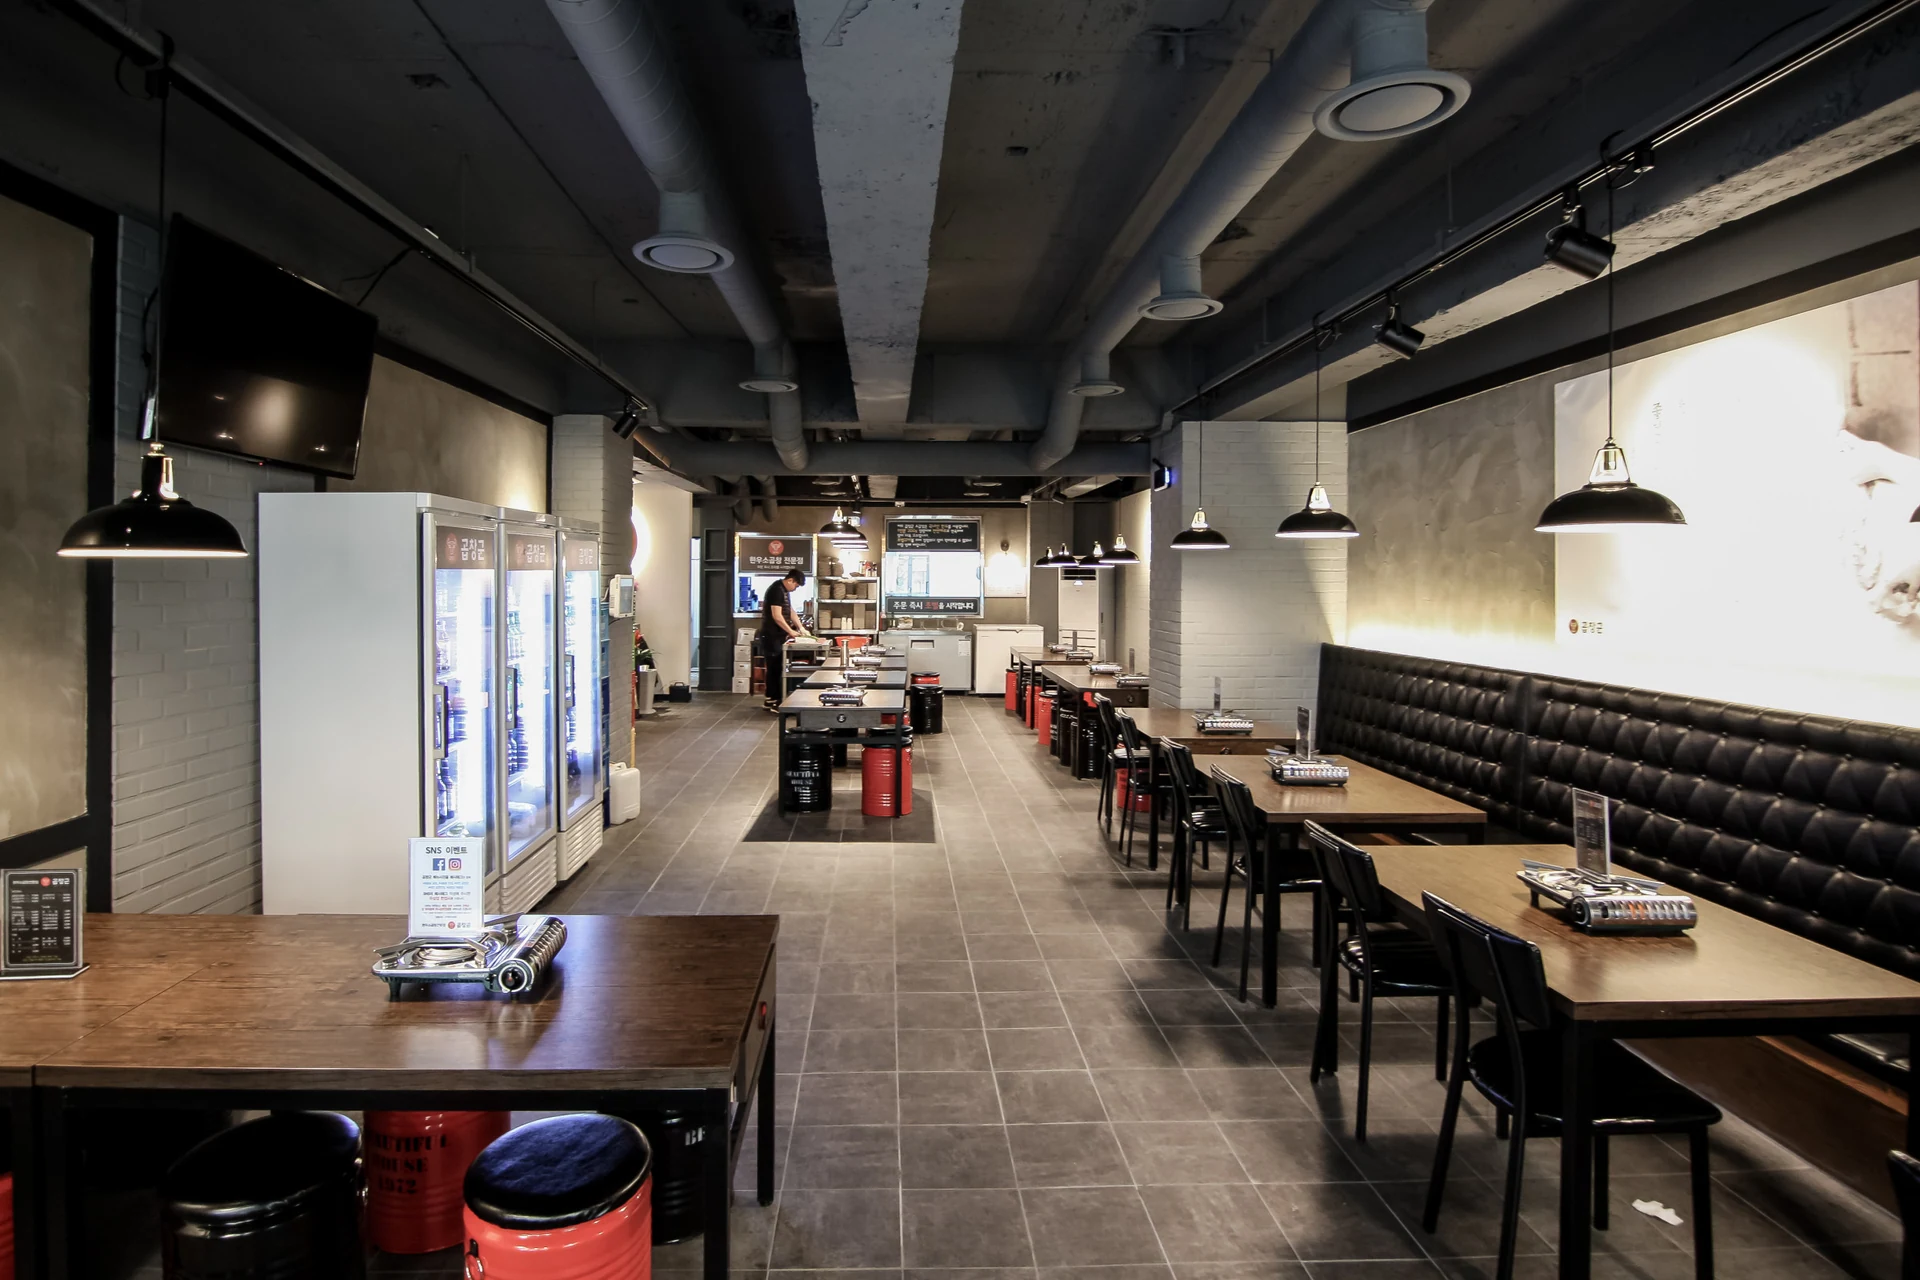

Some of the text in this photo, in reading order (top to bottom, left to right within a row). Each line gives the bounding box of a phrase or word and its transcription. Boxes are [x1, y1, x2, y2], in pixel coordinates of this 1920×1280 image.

[749, 556, 804, 565] 한우소곱창 전문점
[893, 601, 908, 610] 주문
[909, 601, 923, 610] 즉시
[945, 602, 974, 610] 시작합니다
[425, 846, 468, 855] SNS 이벤트
